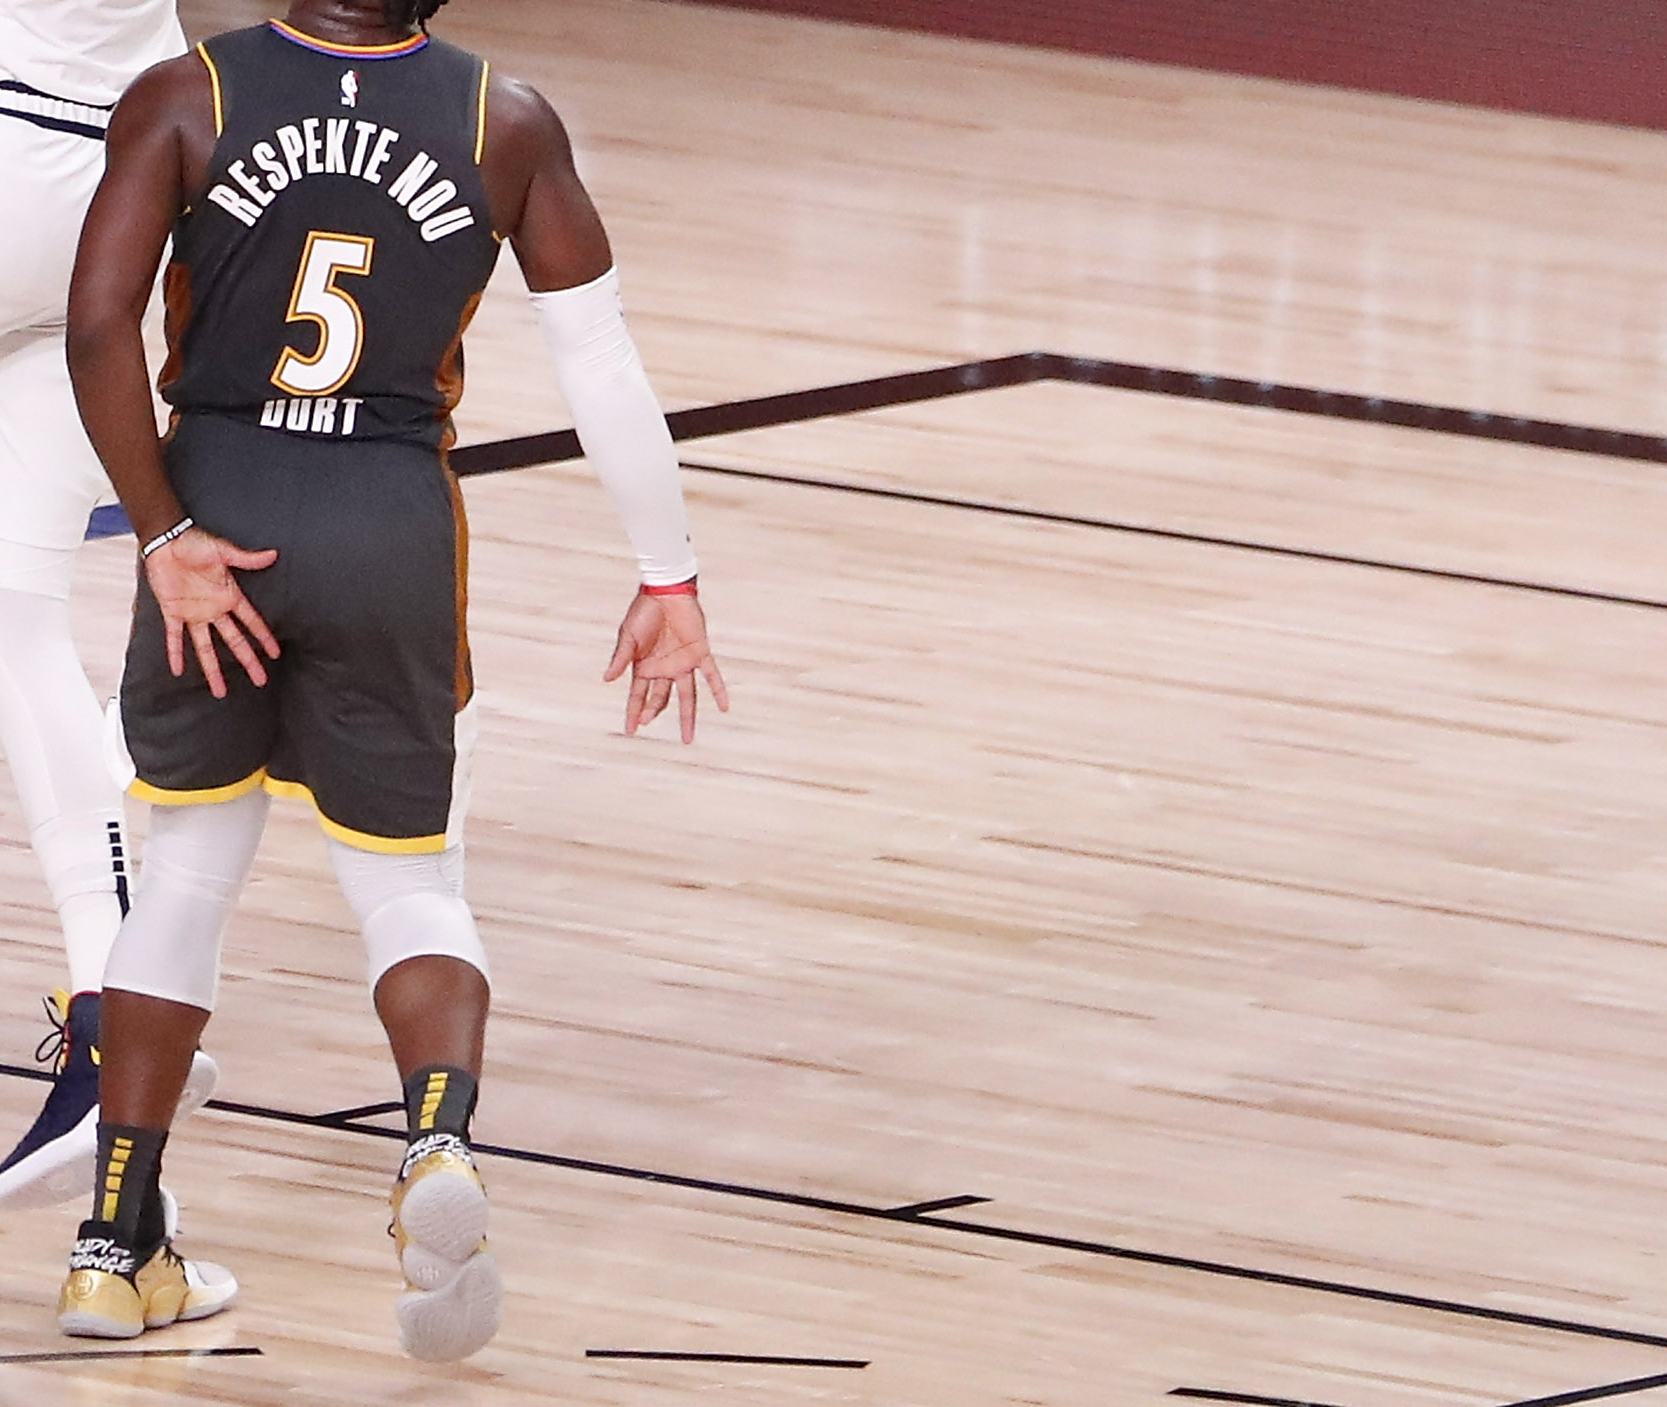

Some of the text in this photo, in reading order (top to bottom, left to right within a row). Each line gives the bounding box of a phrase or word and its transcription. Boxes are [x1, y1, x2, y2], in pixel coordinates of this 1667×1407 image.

[207, 117, 476, 243] RESPEKTE NOU
[269, 229, 376, 397] 5
